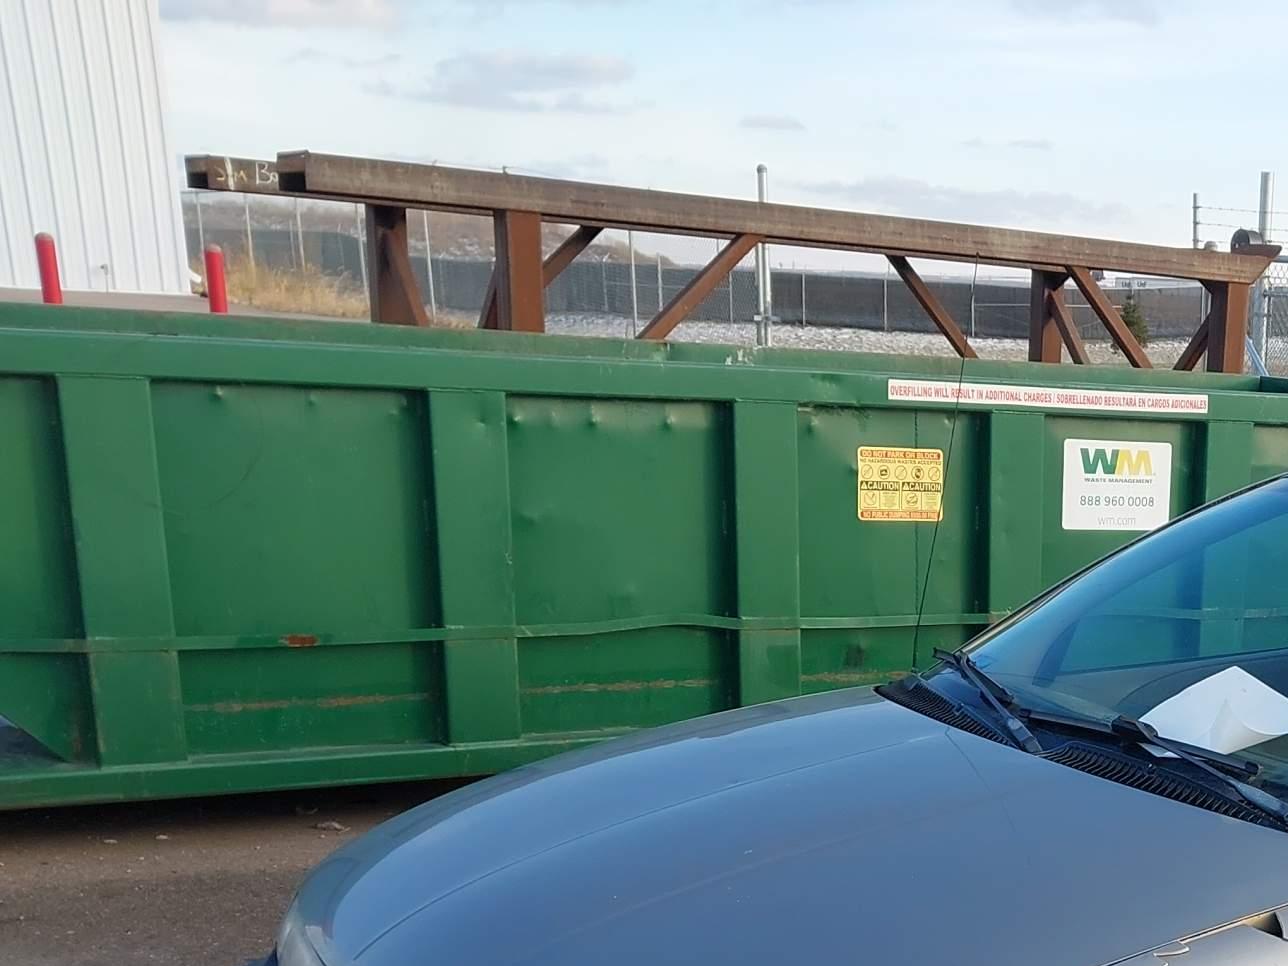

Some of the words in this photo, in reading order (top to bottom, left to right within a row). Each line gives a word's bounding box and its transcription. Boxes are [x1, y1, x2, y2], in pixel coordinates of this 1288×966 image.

[890, 385, 932, 397] OVERFILLING
[934, 386, 949, 398] WILL
[951, 387, 975, 399] RESULT
[977, 389, 983, 400] IN
[985, 390, 1022, 401] ADDITIONAL
[1024, 392, 1052, 403] CHARGES
[1056, 393, 1102, 405] SOBRELLENADO
[1104, 395, 1137, 407] RESULTARÁ
[1138, 397, 1146, 407] EN
[1147, 397, 1170, 409] CARGOS
[1171, 399, 1207, 409] ADICIONALES
[873, 450, 886, 458] NOT
[1080, 448, 1153, 476] WM
[867, 481, 900, 490] CAUTION
[909, 482, 941, 491] CAUTION
[1080, 496, 1101, 506] 888
[1104, 496, 1125, 507] 960
[1128, 497, 1154, 507] 0008
[1097, 517, 1136, 526] wm.com
